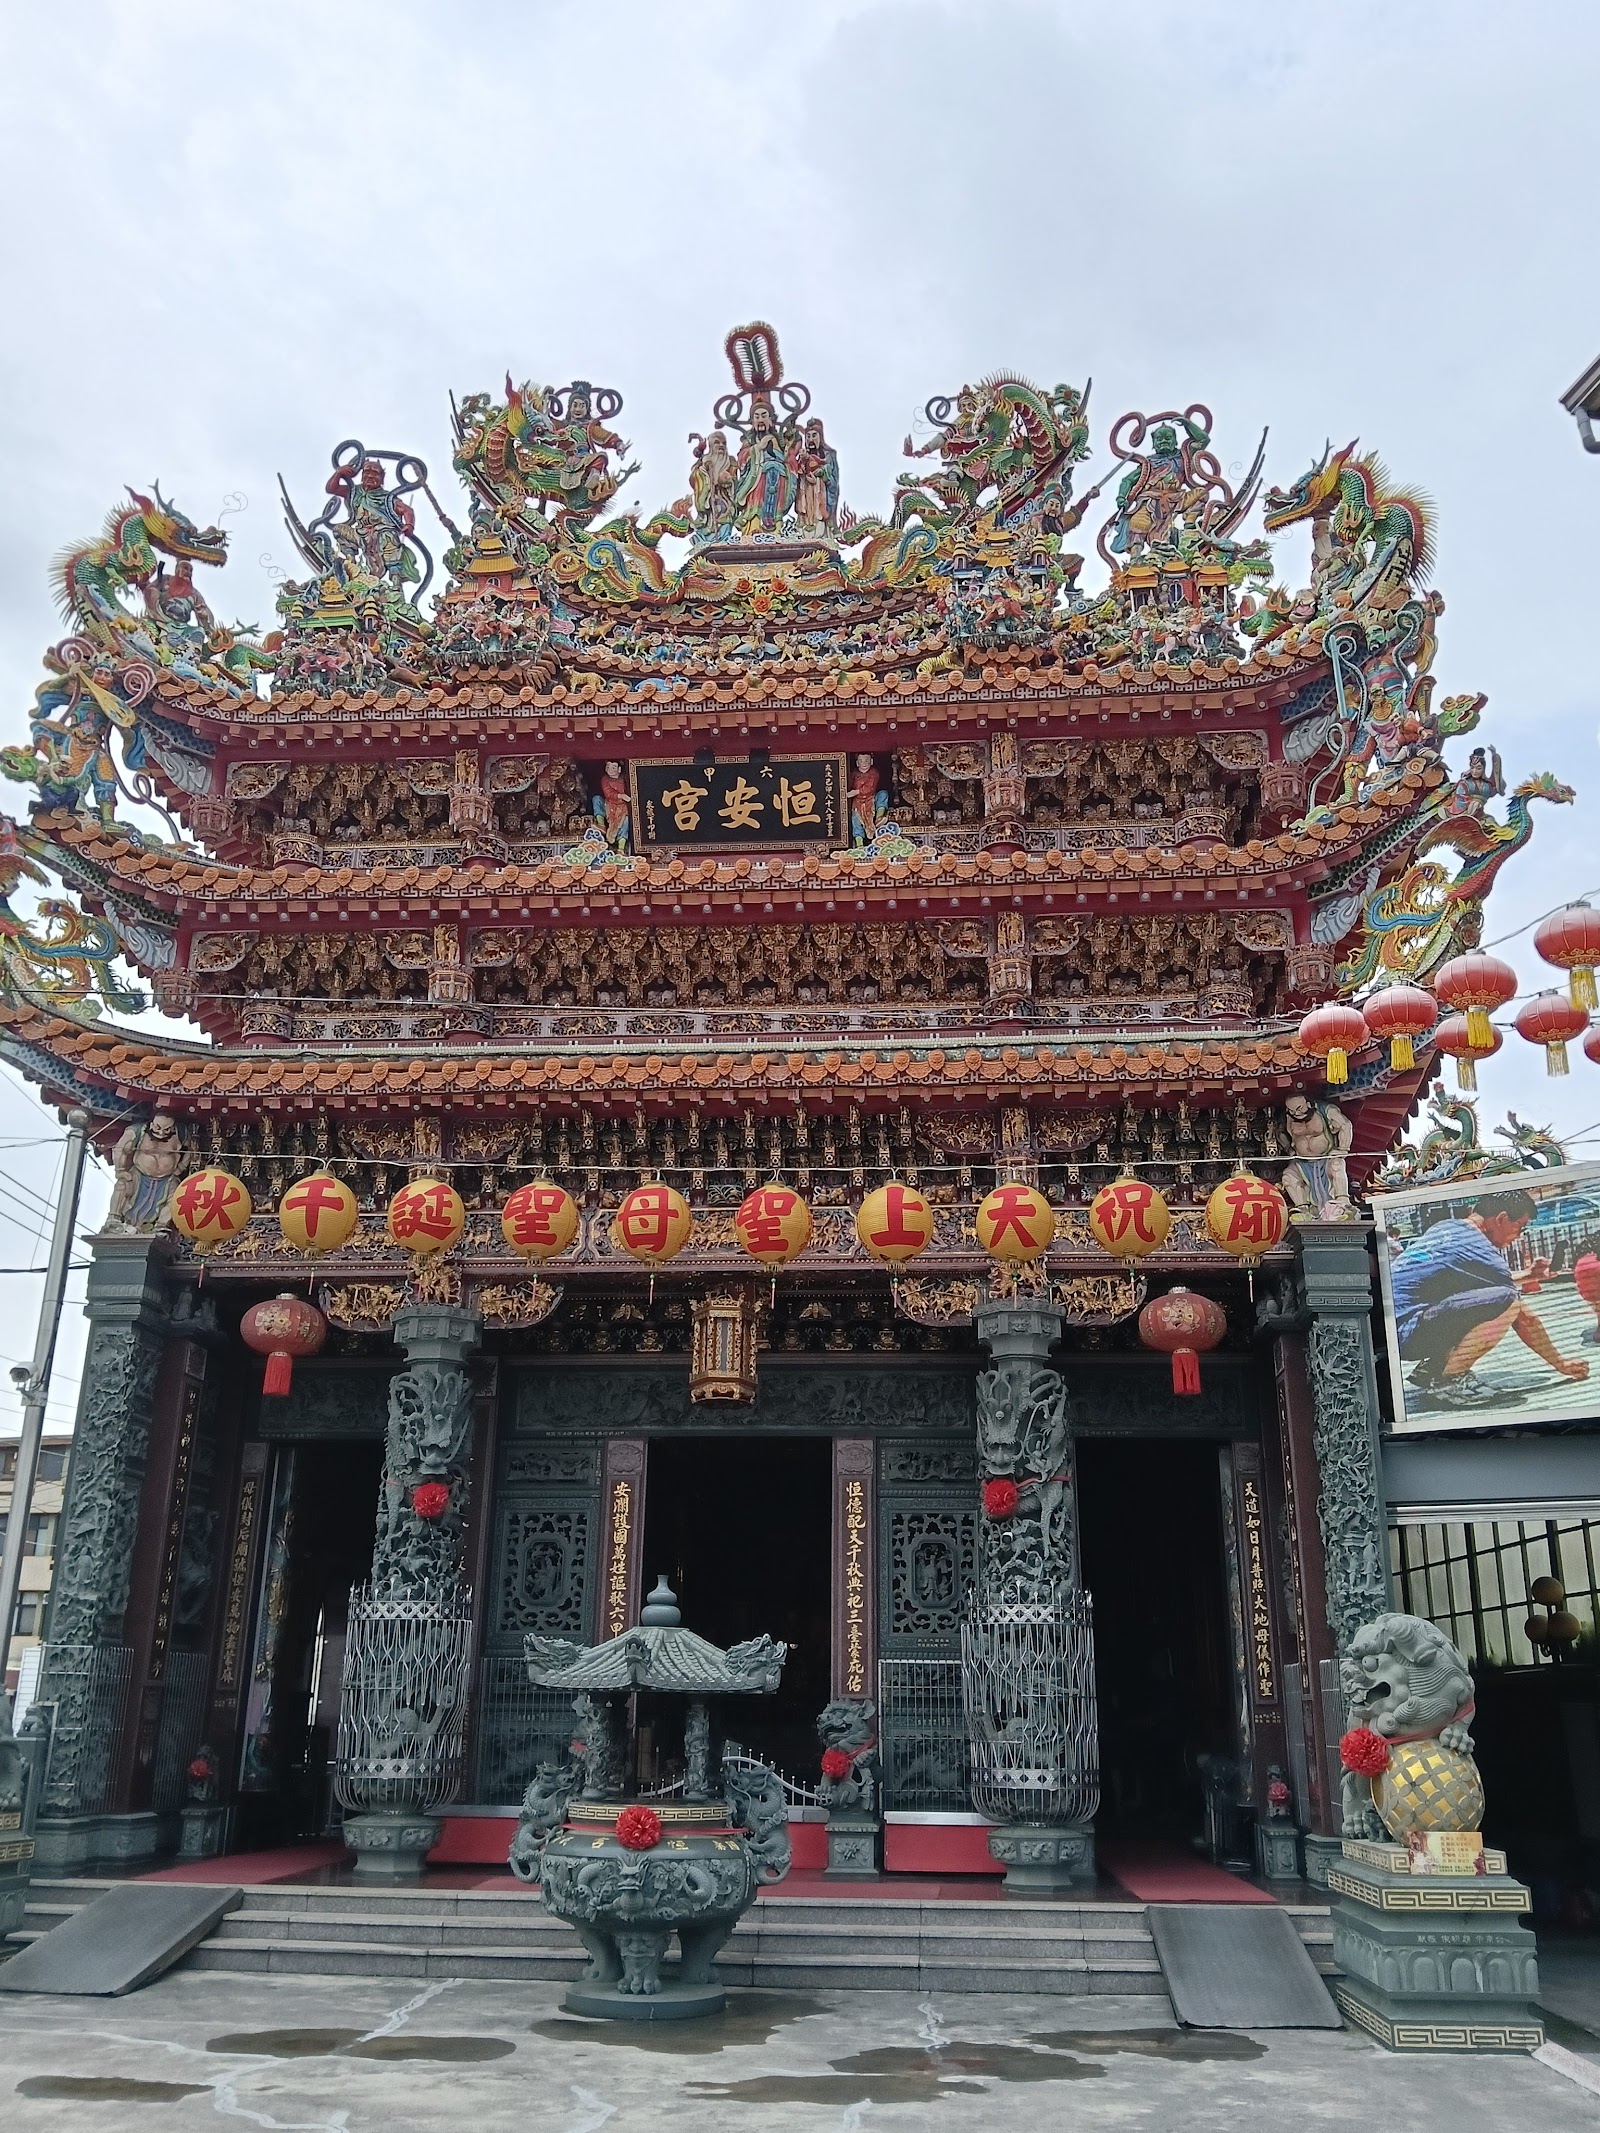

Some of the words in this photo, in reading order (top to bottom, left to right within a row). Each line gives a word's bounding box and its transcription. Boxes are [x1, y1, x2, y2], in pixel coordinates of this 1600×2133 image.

[661, 776, 822, 831] 恒安宮
[177, 1173, 240, 1231] 秋
[286, 1179, 344, 1238] 千
[392, 1185, 456, 1239] 誕
[503, 1185, 567, 1246] 聖
[618, 1188, 678, 1250] 母
[737, 1187, 796, 1253] 聖
[869, 1187, 924, 1247] 上
[985, 1187, 1038, 1247] 天
[1097, 1183, 1155, 1242] 祝
